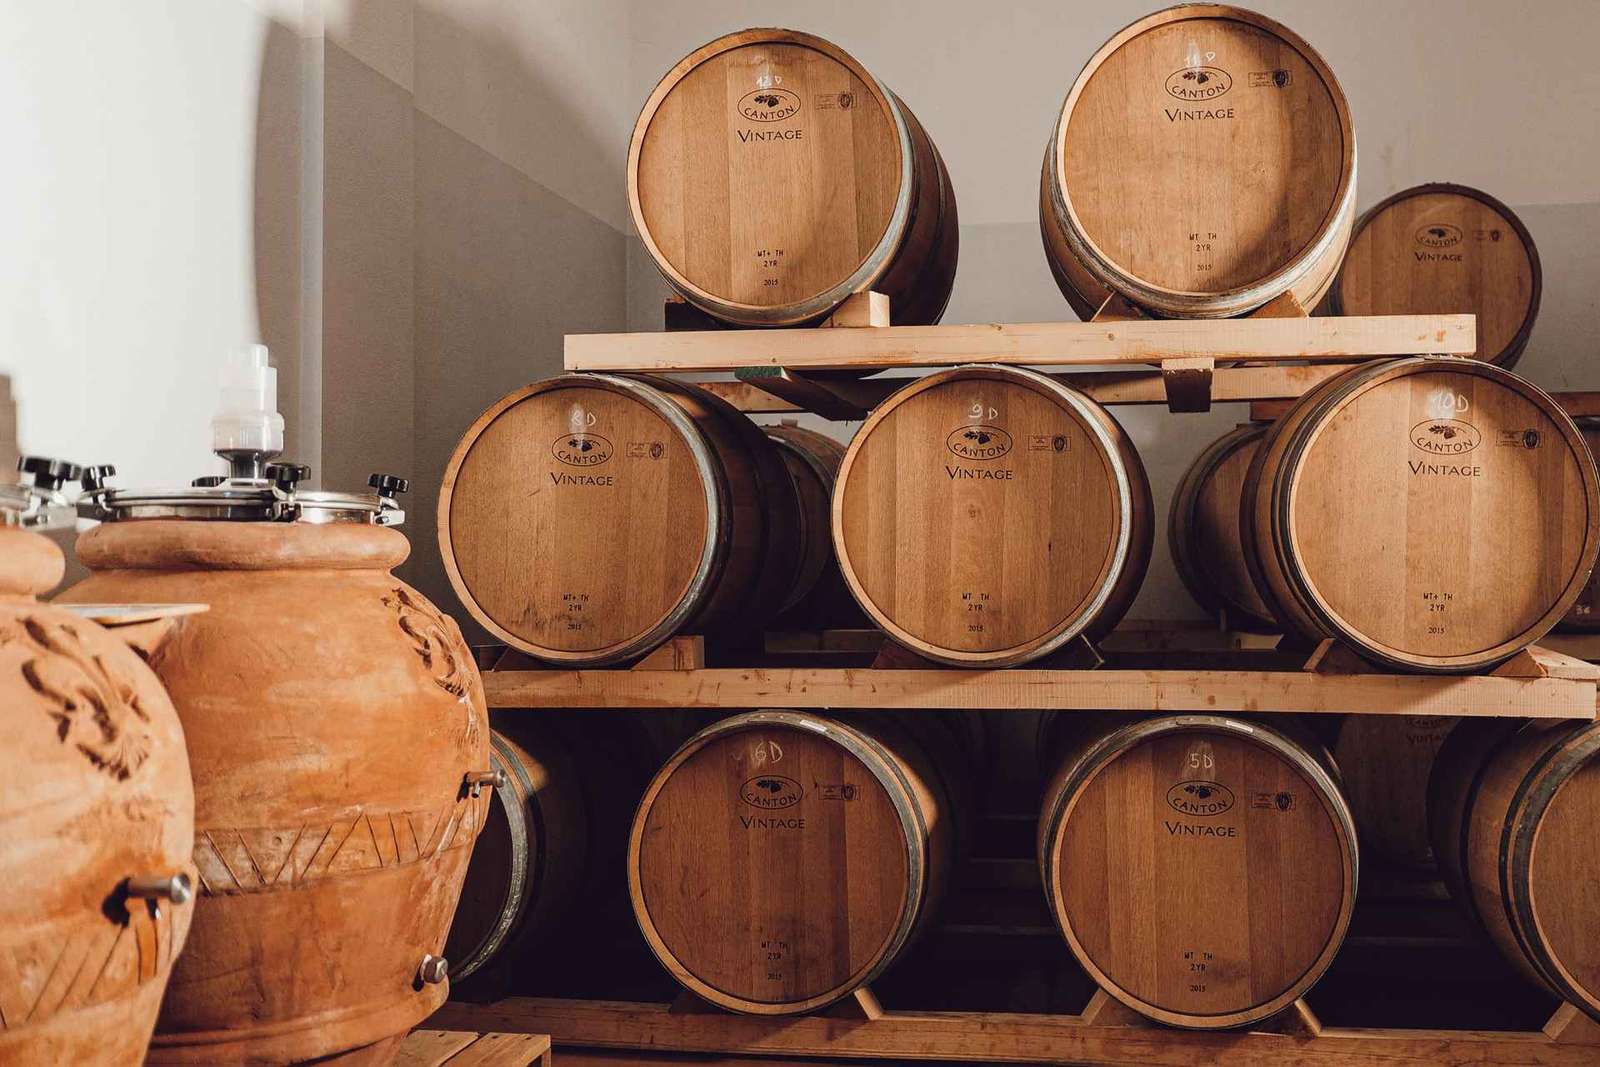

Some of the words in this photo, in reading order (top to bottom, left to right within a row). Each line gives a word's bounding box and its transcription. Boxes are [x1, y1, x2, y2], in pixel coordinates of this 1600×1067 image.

[1171, 83, 1226, 98] CANTON
[744, 105, 794, 119] CANTON
[1195, 244, 1211, 252] 2YR
[1420, 236, 1457, 246] CANTON
[953, 443, 1006, 457] CANTON
[1417, 437, 1473, 452] CANTON
[558, 450, 607, 464] CANTON
[968, 604, 983, 612] 2YR
[1430, 604, 1445, 612] 2YR
[746, 792, 797, 806] CANTON
[1173, 798, 1227, 813] CANTON
[1190, 963, 1206, 971] 2YR
